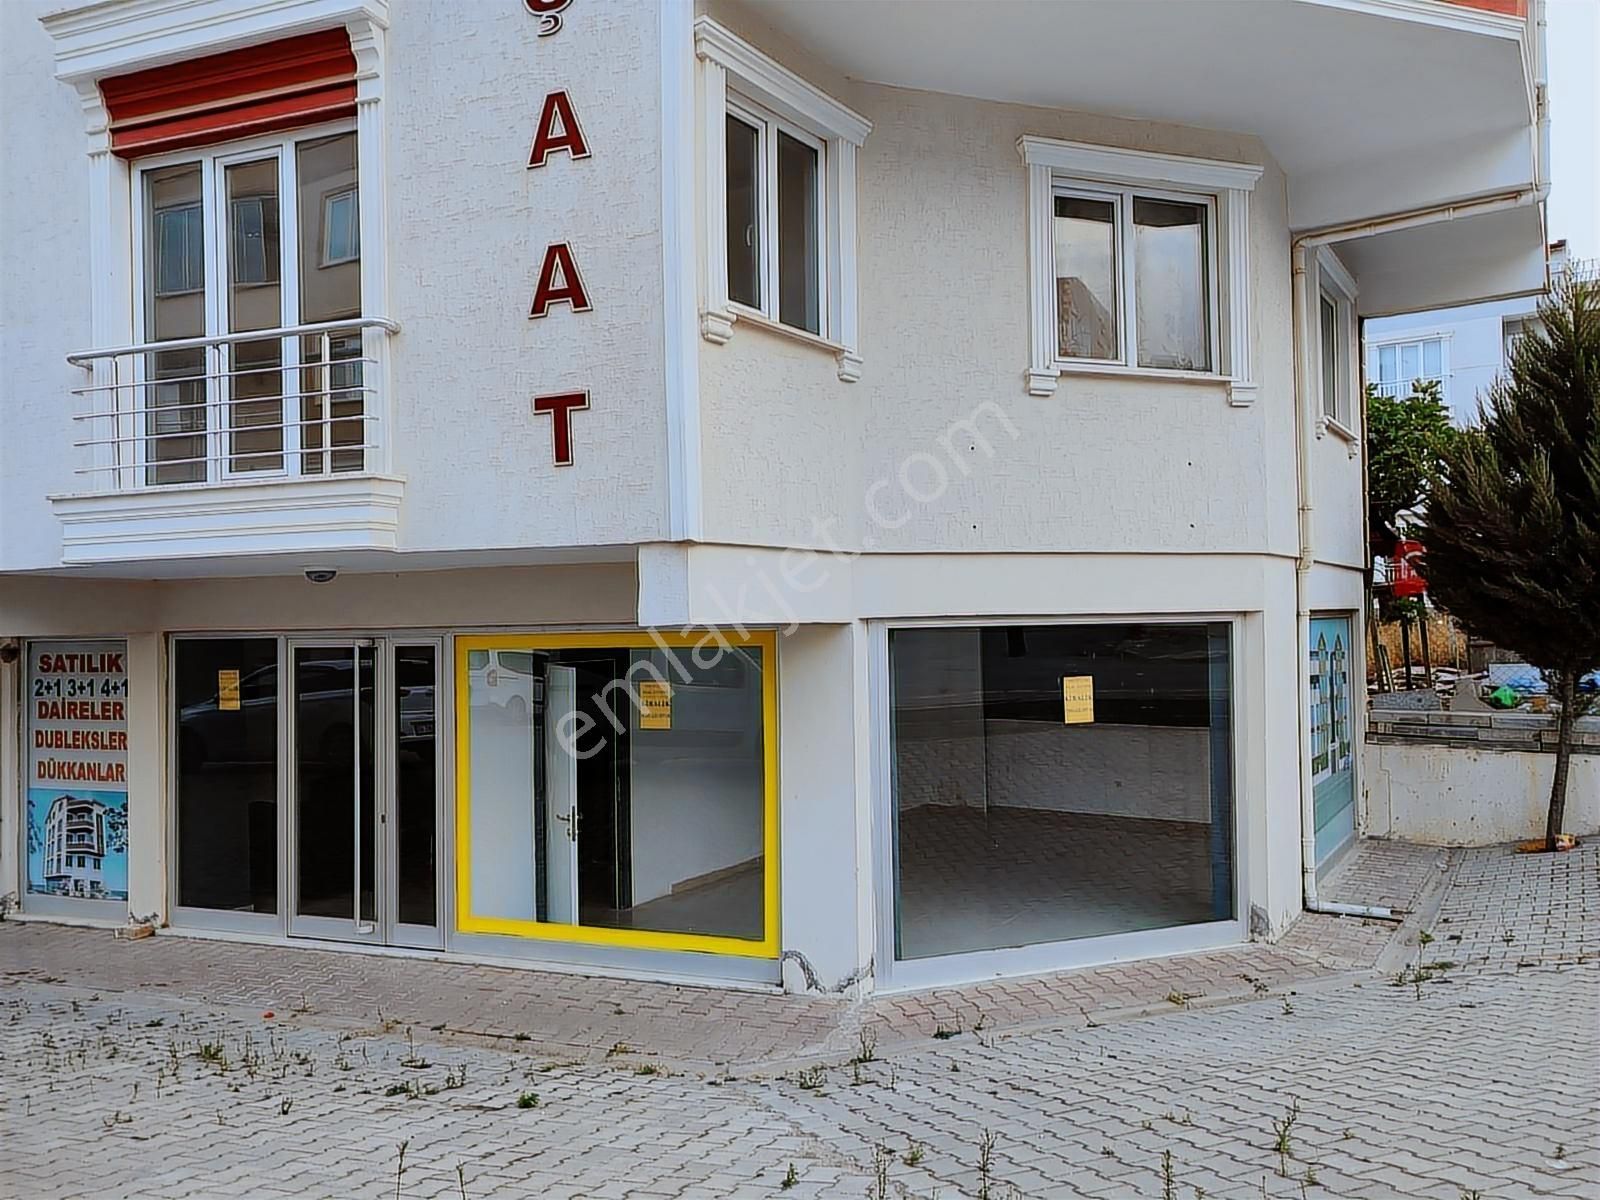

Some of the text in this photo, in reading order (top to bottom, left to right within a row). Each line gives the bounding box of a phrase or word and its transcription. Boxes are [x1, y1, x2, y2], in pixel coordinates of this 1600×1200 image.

[38, 653, 123, 673] SATILIK
[34, 678, 128, 697] 2+1 3+1 4+1
[37, 697, 125, 720] DAİRELER
[35, 730, 128, 750] DUBLEKSLER
[37, 758, 125, 782] DÜKKANLAR
